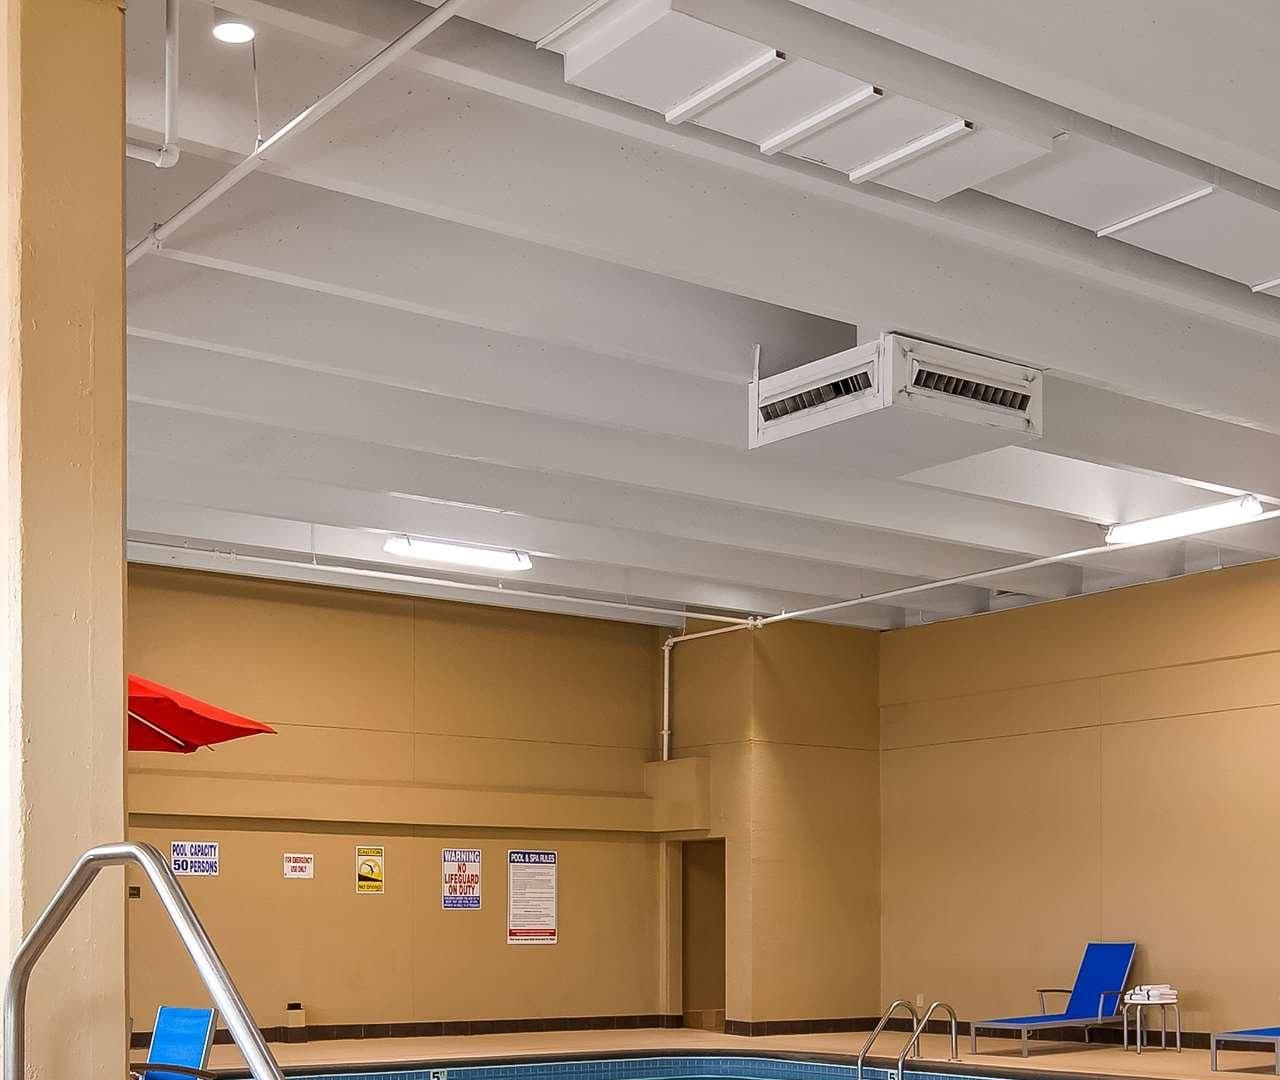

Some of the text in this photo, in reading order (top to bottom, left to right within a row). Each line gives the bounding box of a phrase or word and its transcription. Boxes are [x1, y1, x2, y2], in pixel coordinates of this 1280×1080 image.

[172, 843, 218, 857] POOL CAPACITY
[444, 850, 480, 862] WARNING
[510, 853, 524, 863] POOL
[529, 854, 540, 863] SPA
[540, 854, 555, 864] RULES
[173, 859, 218, 873] 50 PERSONS
[457, 863, 467, 873] NO
[445, 873, 479, 884] LIFEGUARD
[448, 885, 476, 895] ON DUTY
